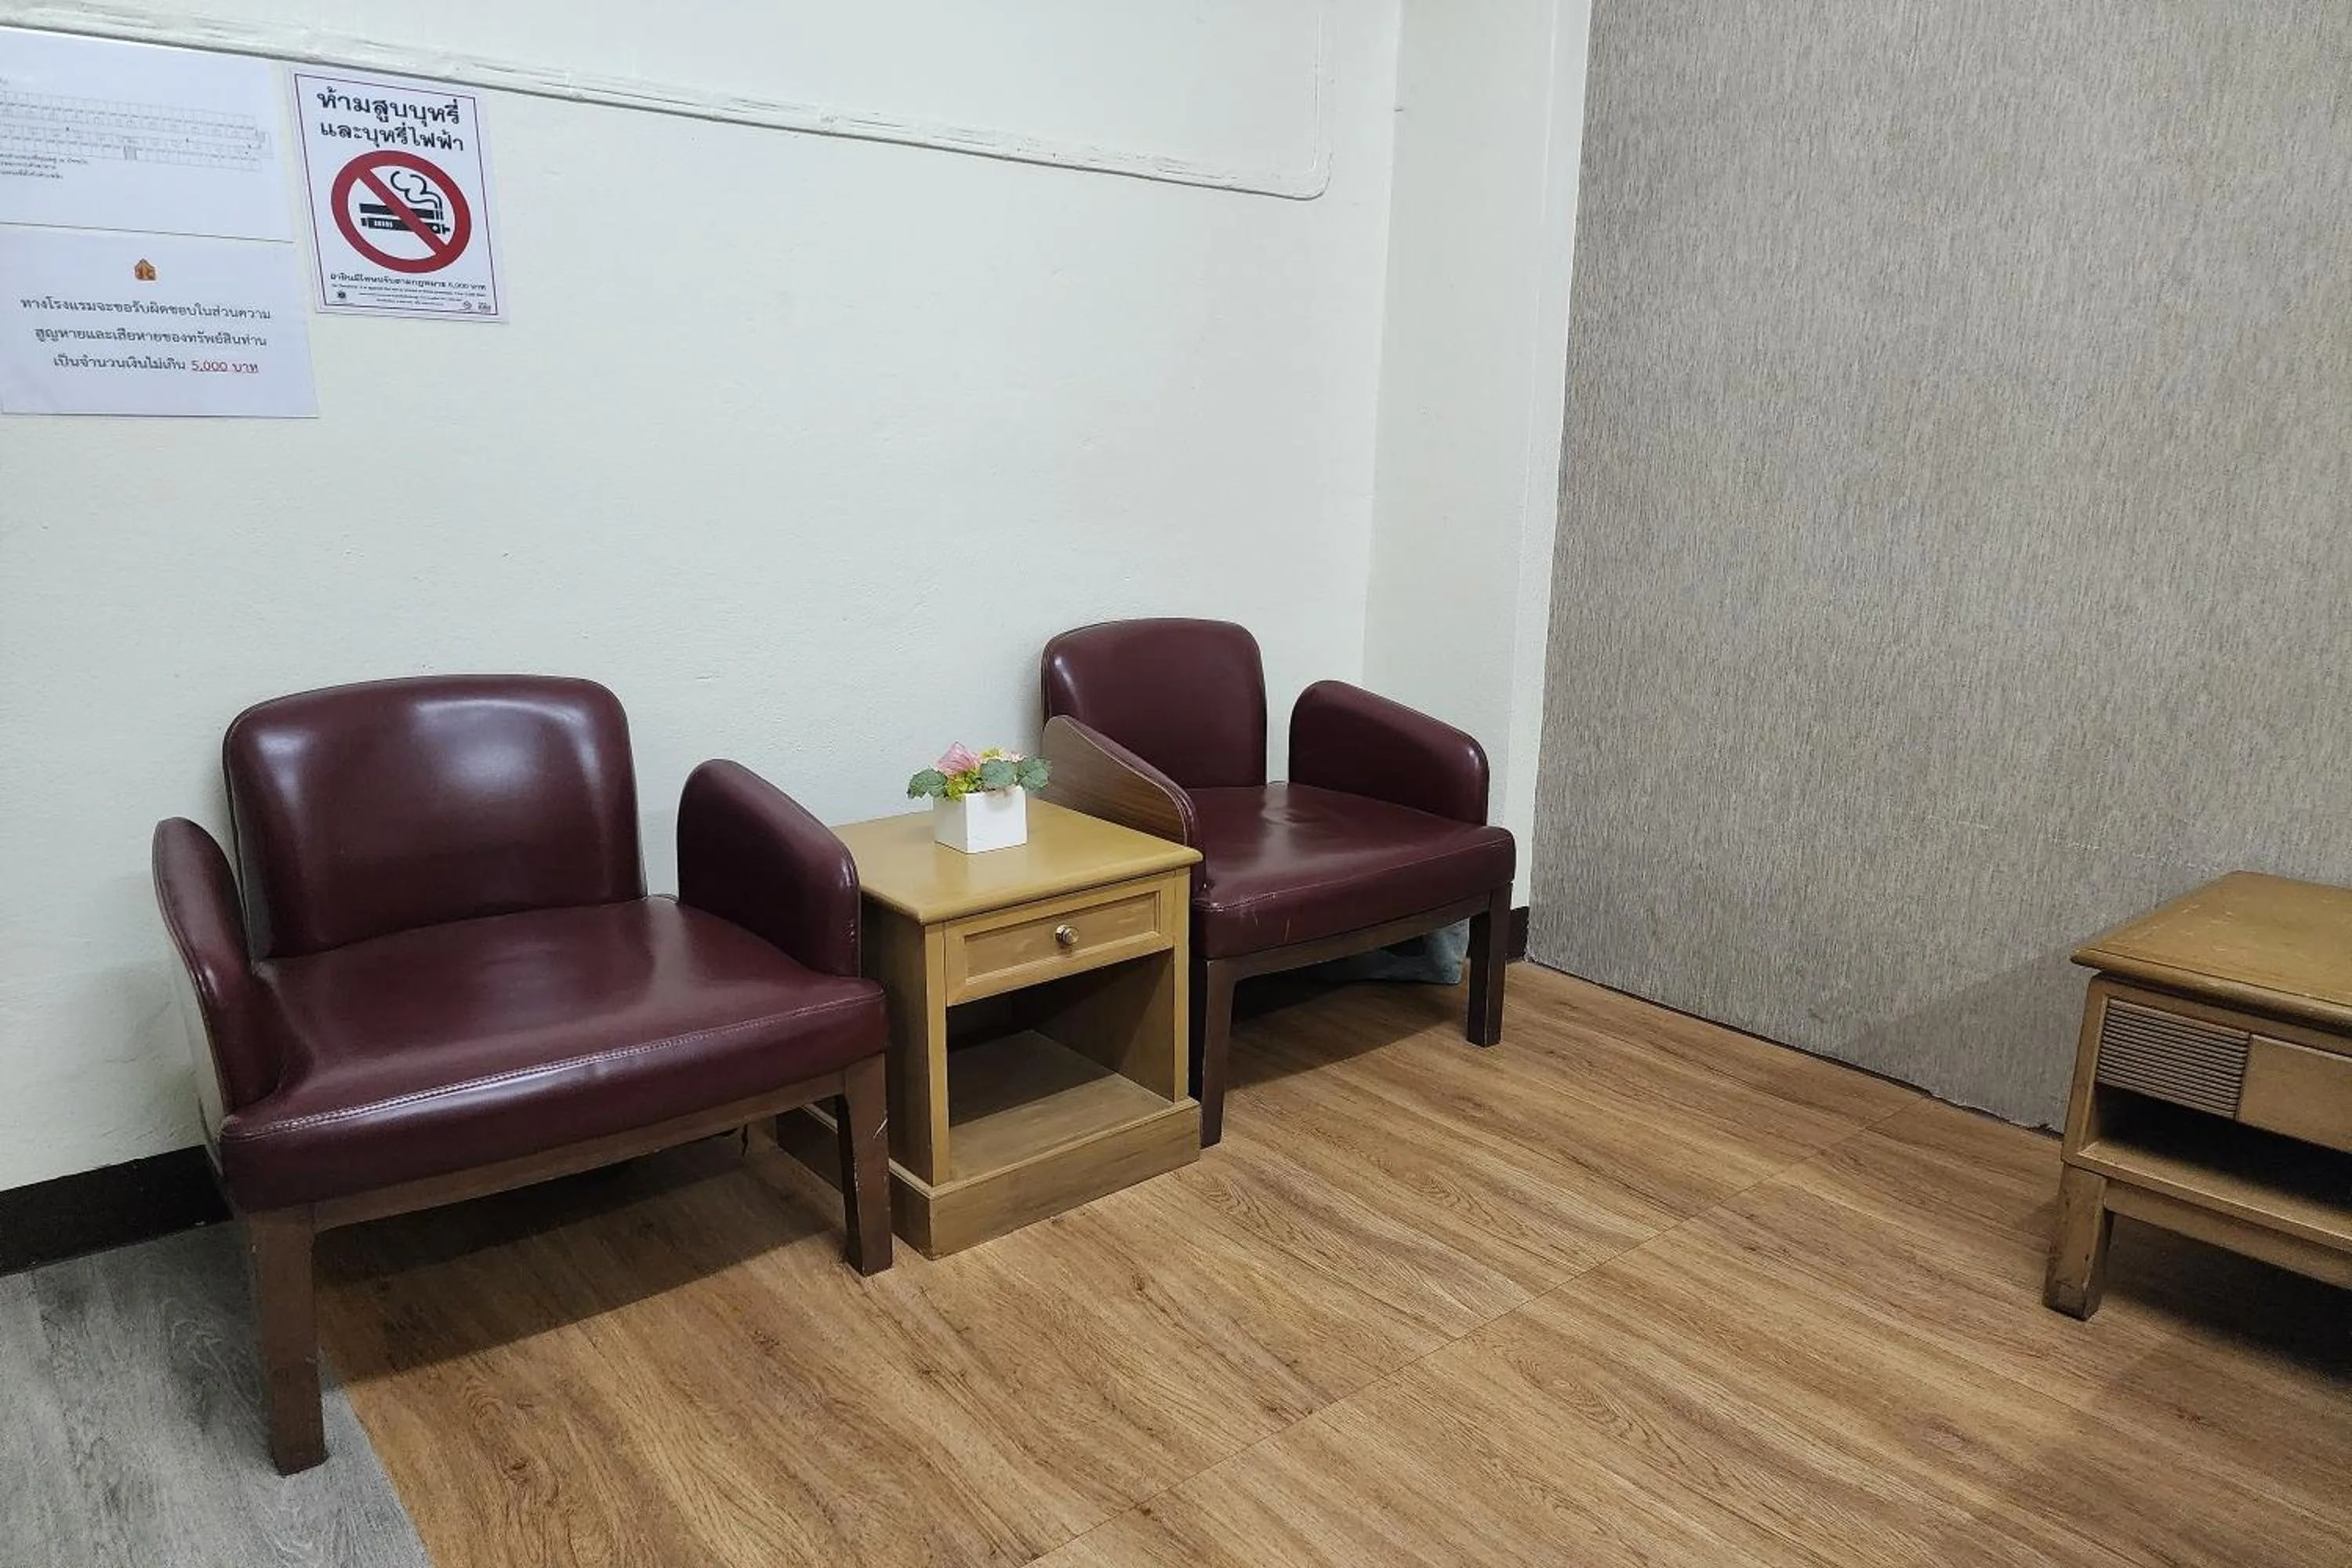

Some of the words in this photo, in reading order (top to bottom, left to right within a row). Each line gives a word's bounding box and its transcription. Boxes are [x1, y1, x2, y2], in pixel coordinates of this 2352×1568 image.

[317, 86, 460, 127] ห้ามสูบบุหรี่
[320, 122, 464, 151] และบุหรี่ไฟฟ้า
[191, 359, 228, 372] 5,000
[232, 362, 259, 373] บาท
